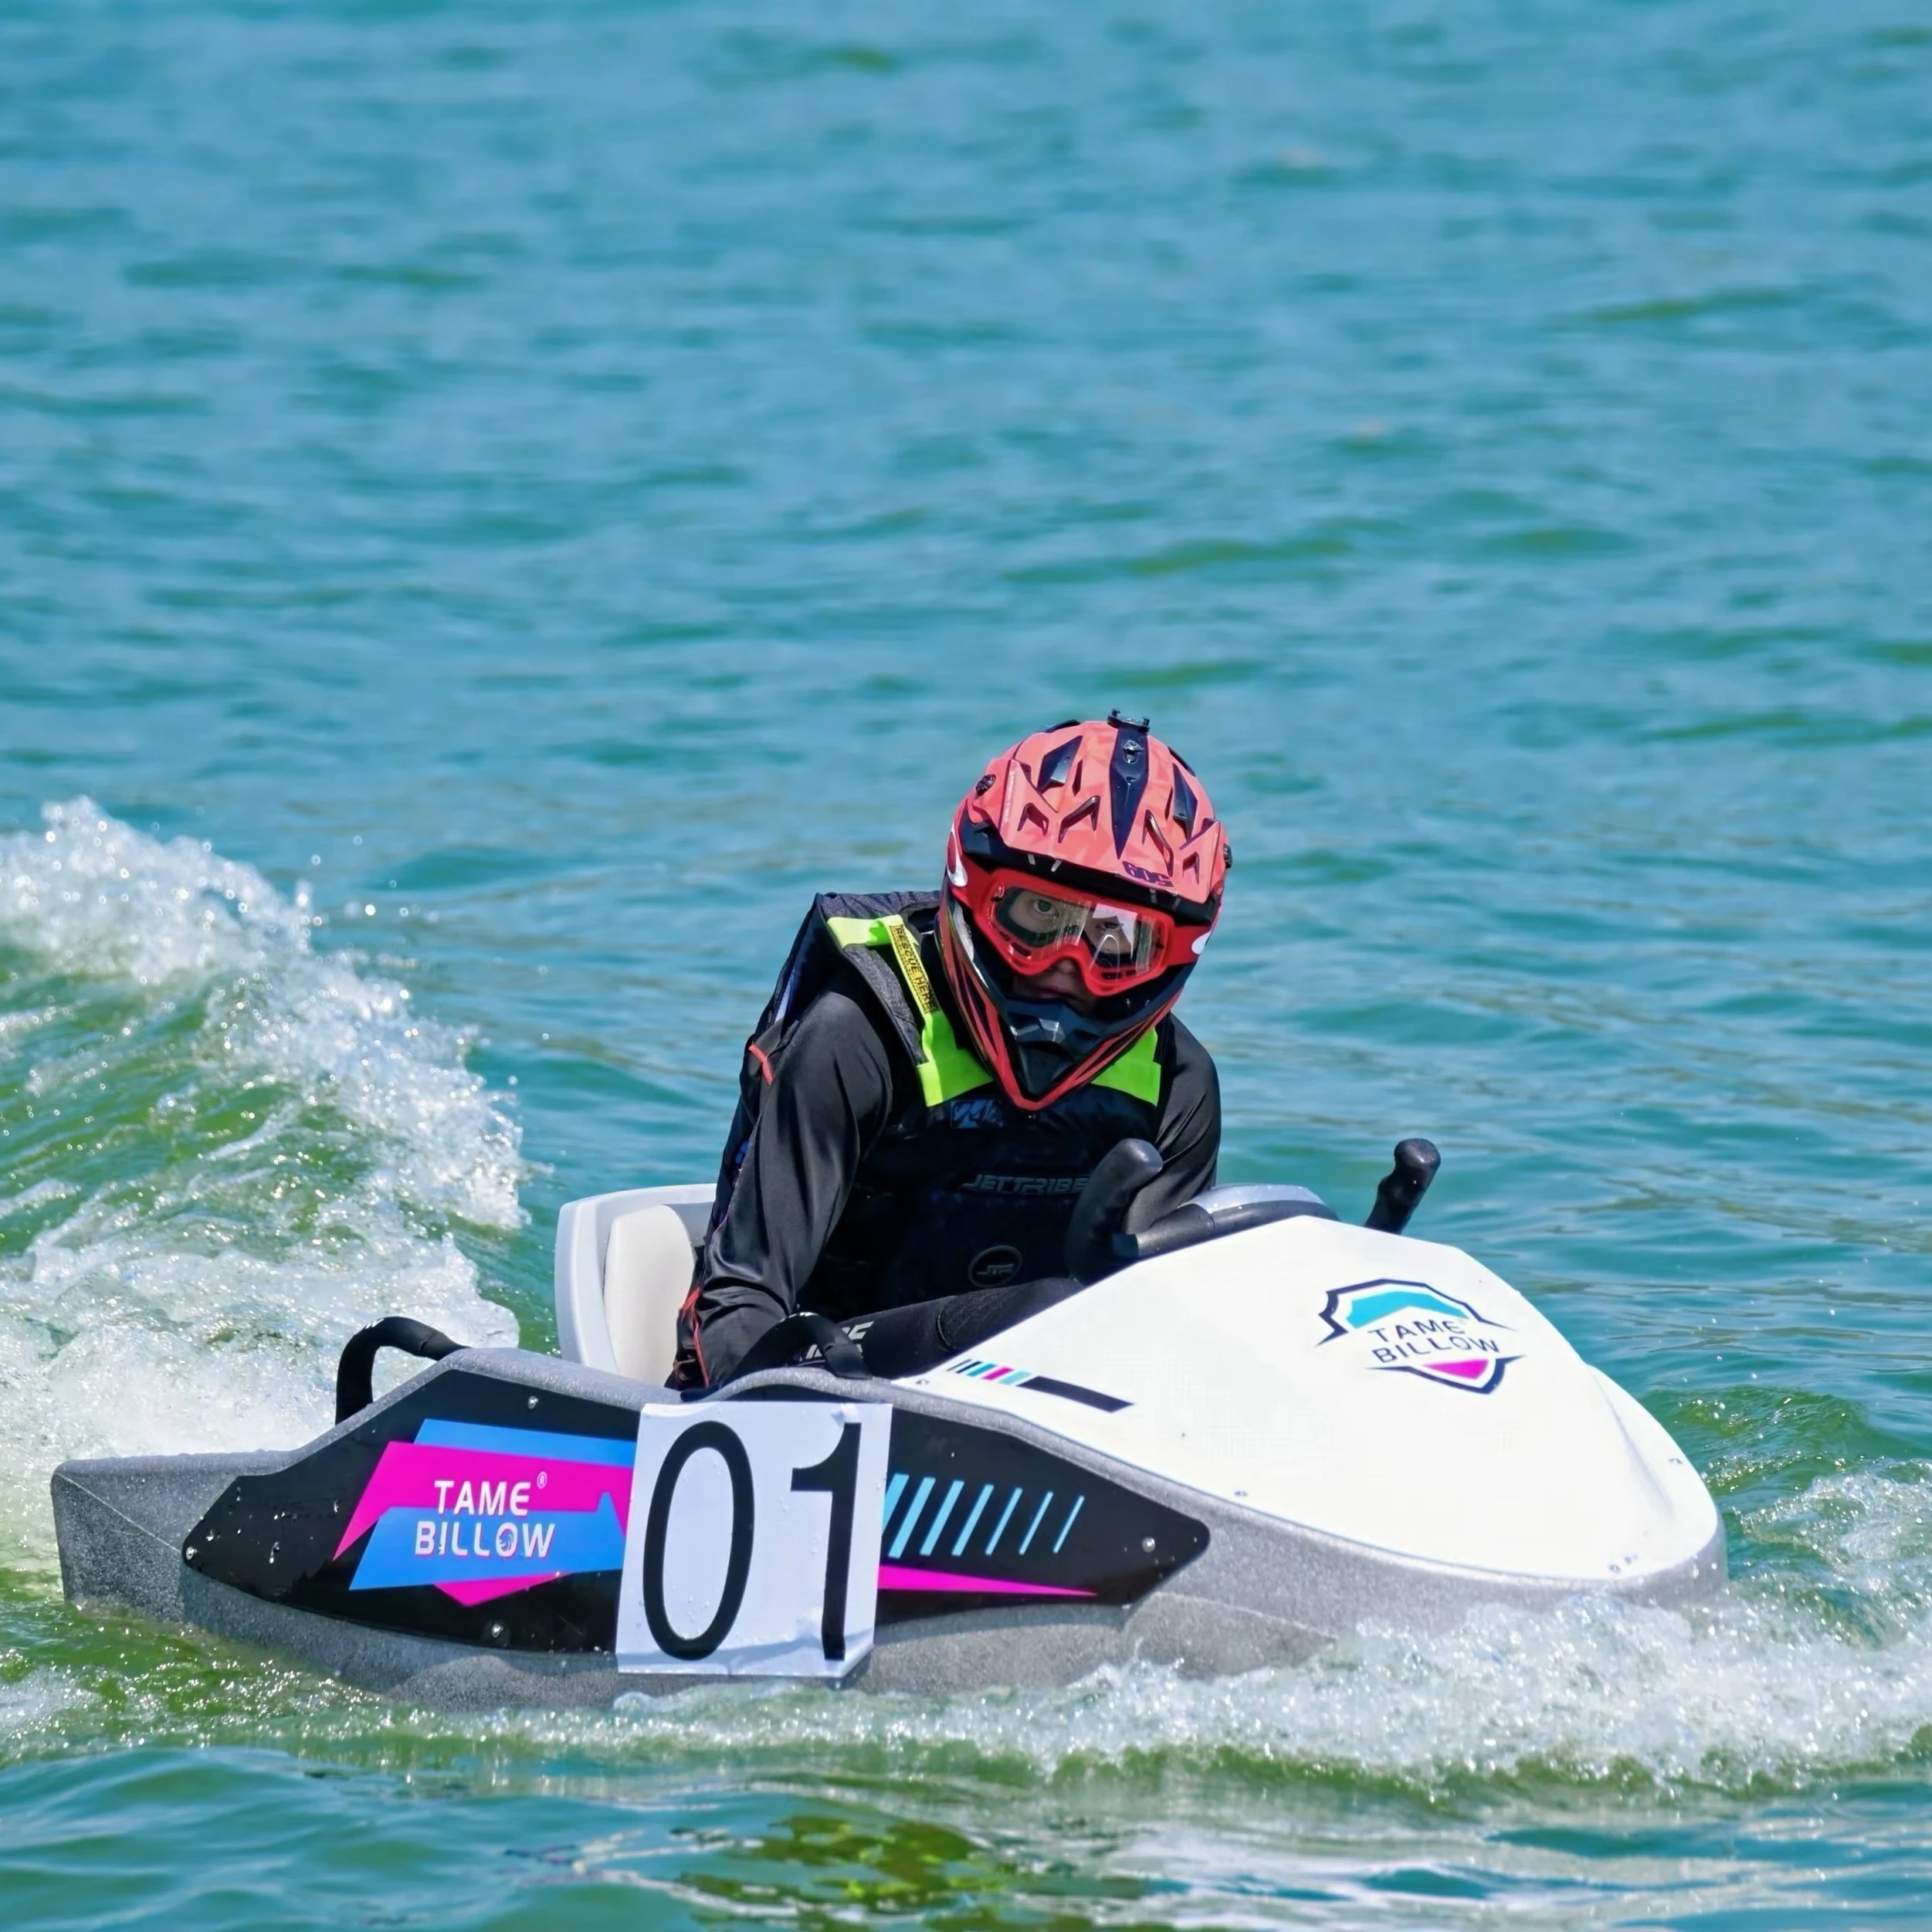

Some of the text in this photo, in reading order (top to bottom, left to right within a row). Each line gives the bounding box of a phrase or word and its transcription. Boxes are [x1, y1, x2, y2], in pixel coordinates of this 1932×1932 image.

[896, 927, 920, 973] RESCUE
[915, 975, 937, 1009] HERE
[1367, 1319, 1466, 1342] TAME
[1371, 1336, 1501, 1363] BILLOW
[415, 1520, 555, 1558] BILLOW
[642, 1420, 862, 1661] 01
